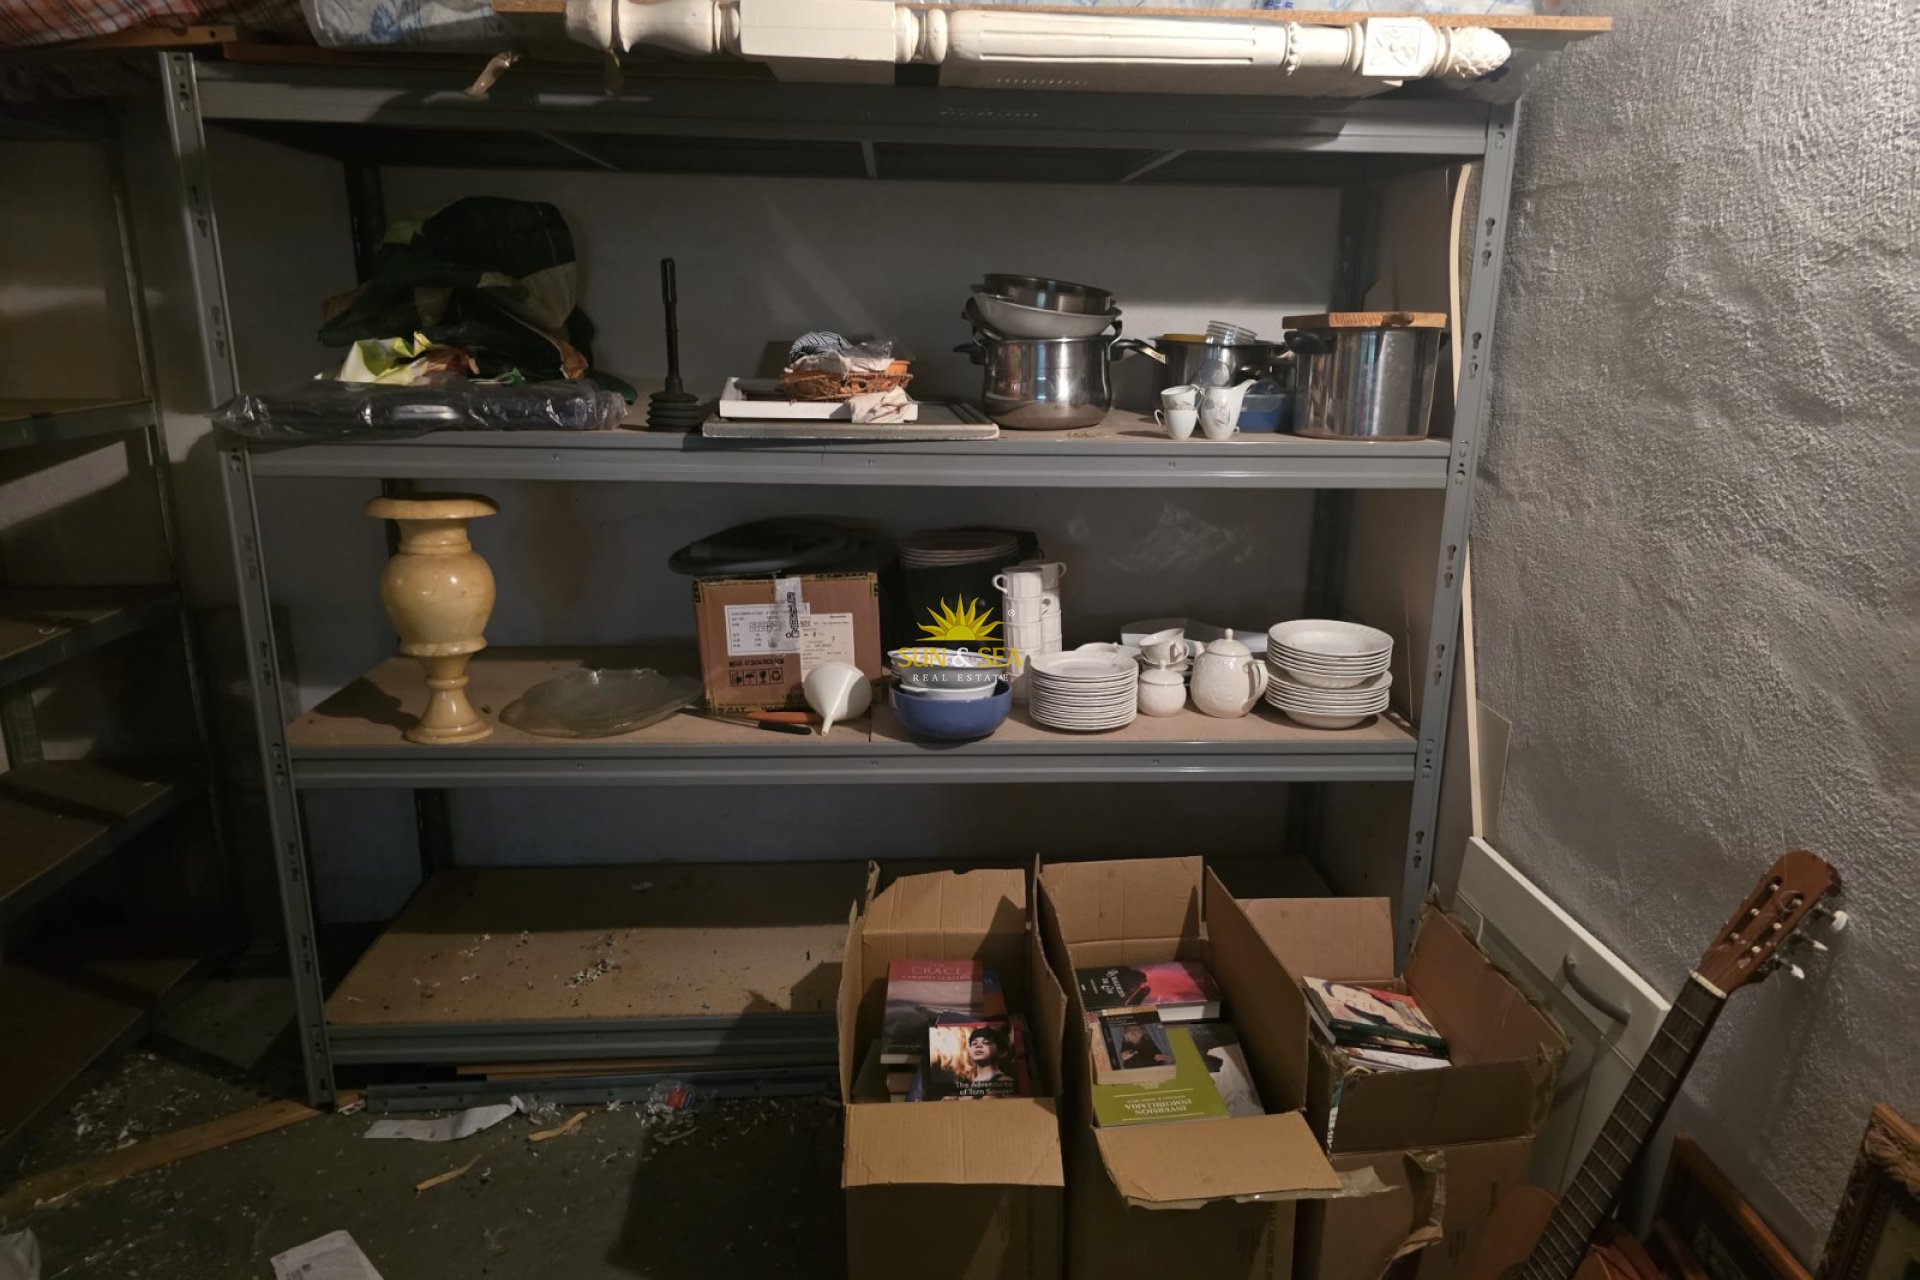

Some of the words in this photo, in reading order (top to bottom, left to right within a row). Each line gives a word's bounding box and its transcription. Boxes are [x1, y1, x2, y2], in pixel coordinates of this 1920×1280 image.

[956, 1081, 969, 1089] The
[971, 1080, 1014, 1088] Adventures
[959, 1088, 967, 1096] of
[969, 1088, 985, 1096] Tom
[986, 1088, 1015, 1096] Sawyer
